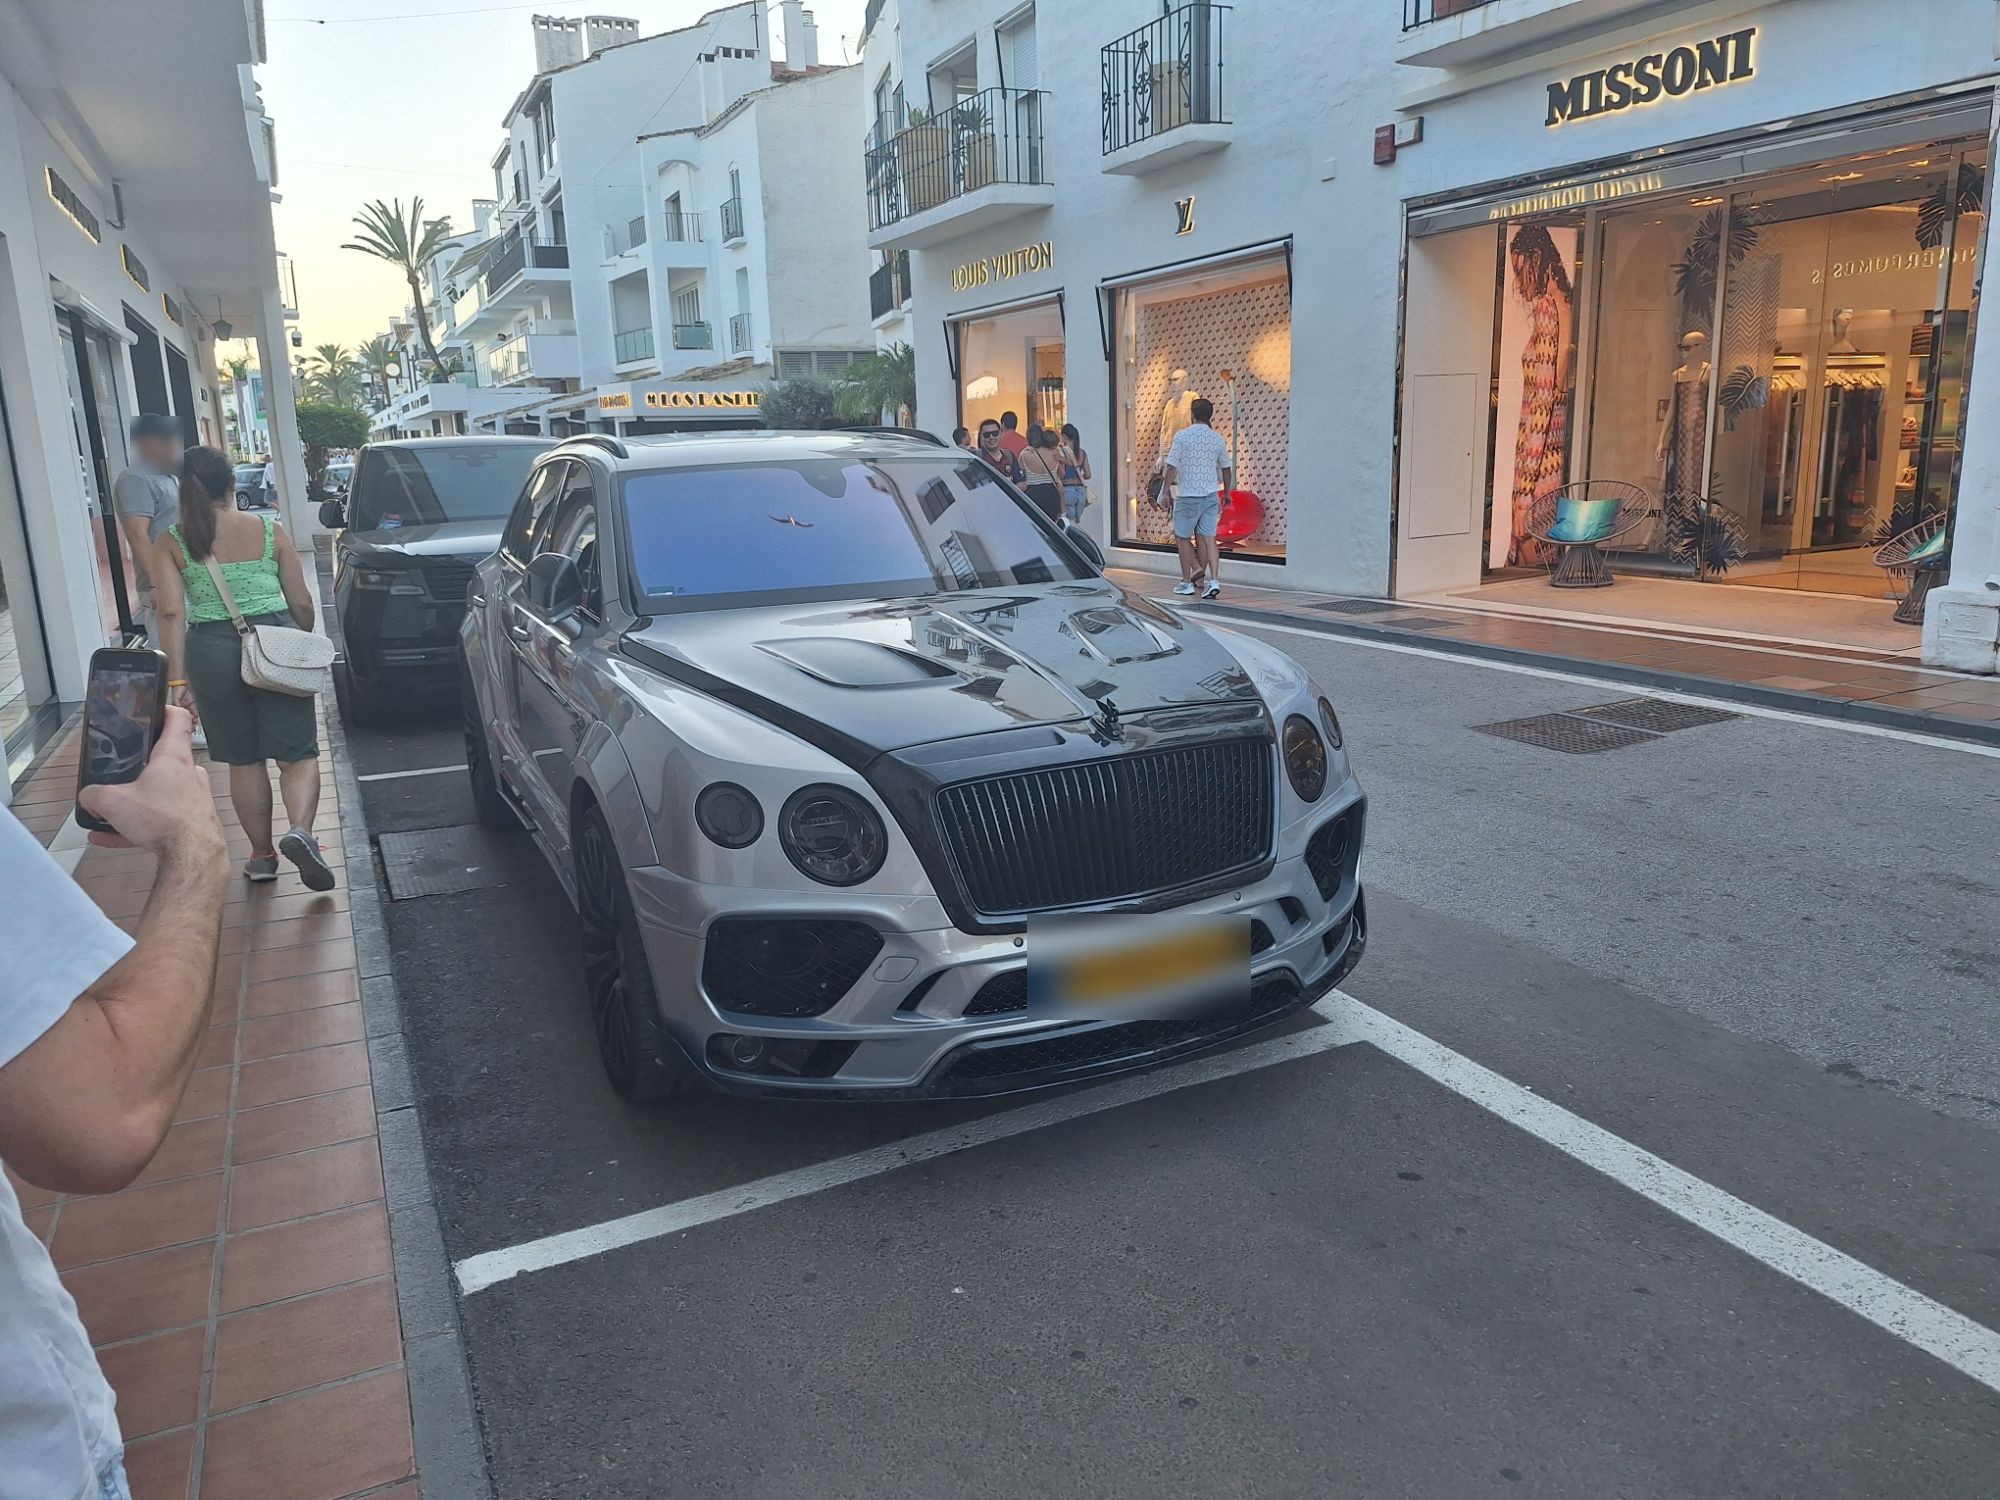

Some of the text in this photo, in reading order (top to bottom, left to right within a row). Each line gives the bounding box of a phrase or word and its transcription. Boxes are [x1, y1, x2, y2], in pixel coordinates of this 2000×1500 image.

[1545, 27, 1757, 126] MISSONI
[952, 240, 1053, 292] LOUIS VUITTON
[661, 393, 693, 407] LOS
